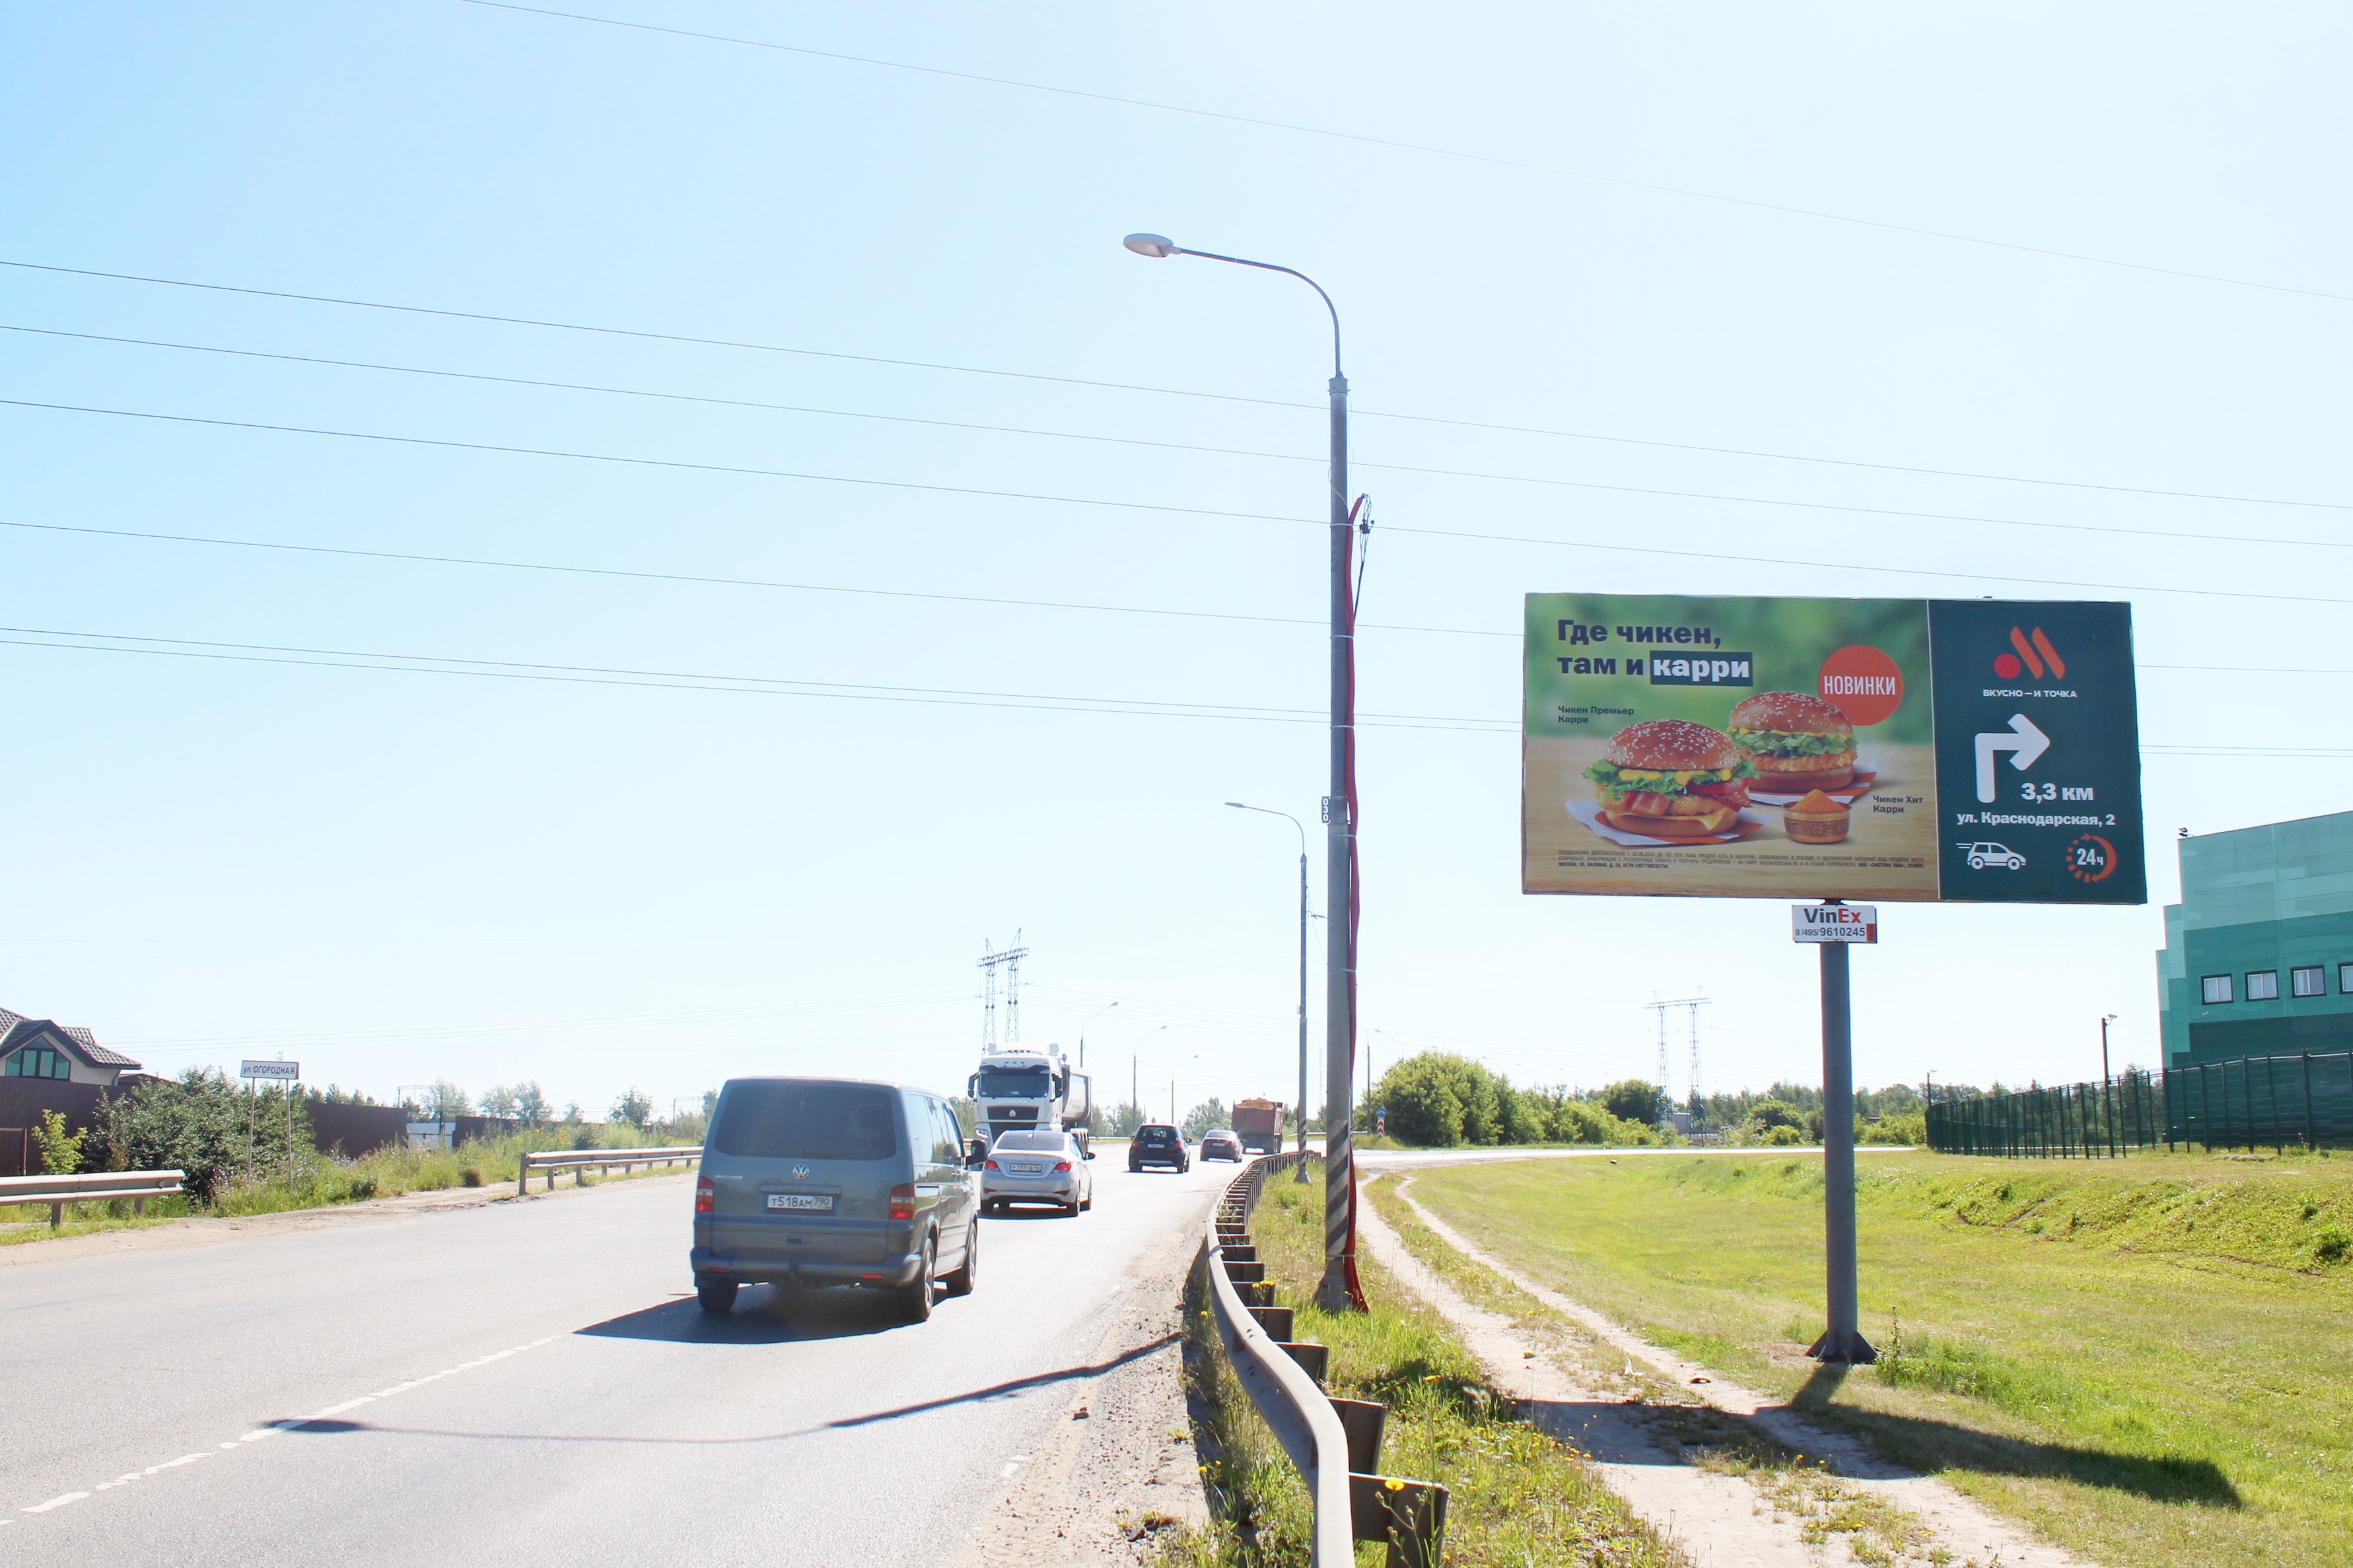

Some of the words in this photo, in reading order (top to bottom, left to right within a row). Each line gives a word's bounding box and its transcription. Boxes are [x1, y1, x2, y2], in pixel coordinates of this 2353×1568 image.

[1558, 620, 1607, 645] Где
[1617, 626, 1721, 649] чикен,
[1557, 657, 1616, 675] там
[1626, 659, 1644, 675] и
[1654, 659, 1749, 682] карри
[1824, 675, 1895, 695] НОВИНКИ
[1983, 689, 2023, 697] ВКУСНО
[1591, 706, 1634, 716] Премьер
[1559, 715, 1589, 724] Карри
[2021, 782, 2057, 803] 3,3
[2062, 787, 2093, 801] км
[1873, 795, 1903, 803] Чикен
[1873, 805, 1904, 814] Карри
[1957, 813, 1978, 825] ул.
[1981, 811, 2102, 827] Краснодарская,
[2105, 813, 2115, 825] 2
[1804, 908, 1862, 923] VinEx
[254, 1065, 295, 1075] ОГОРОДНАЯ
